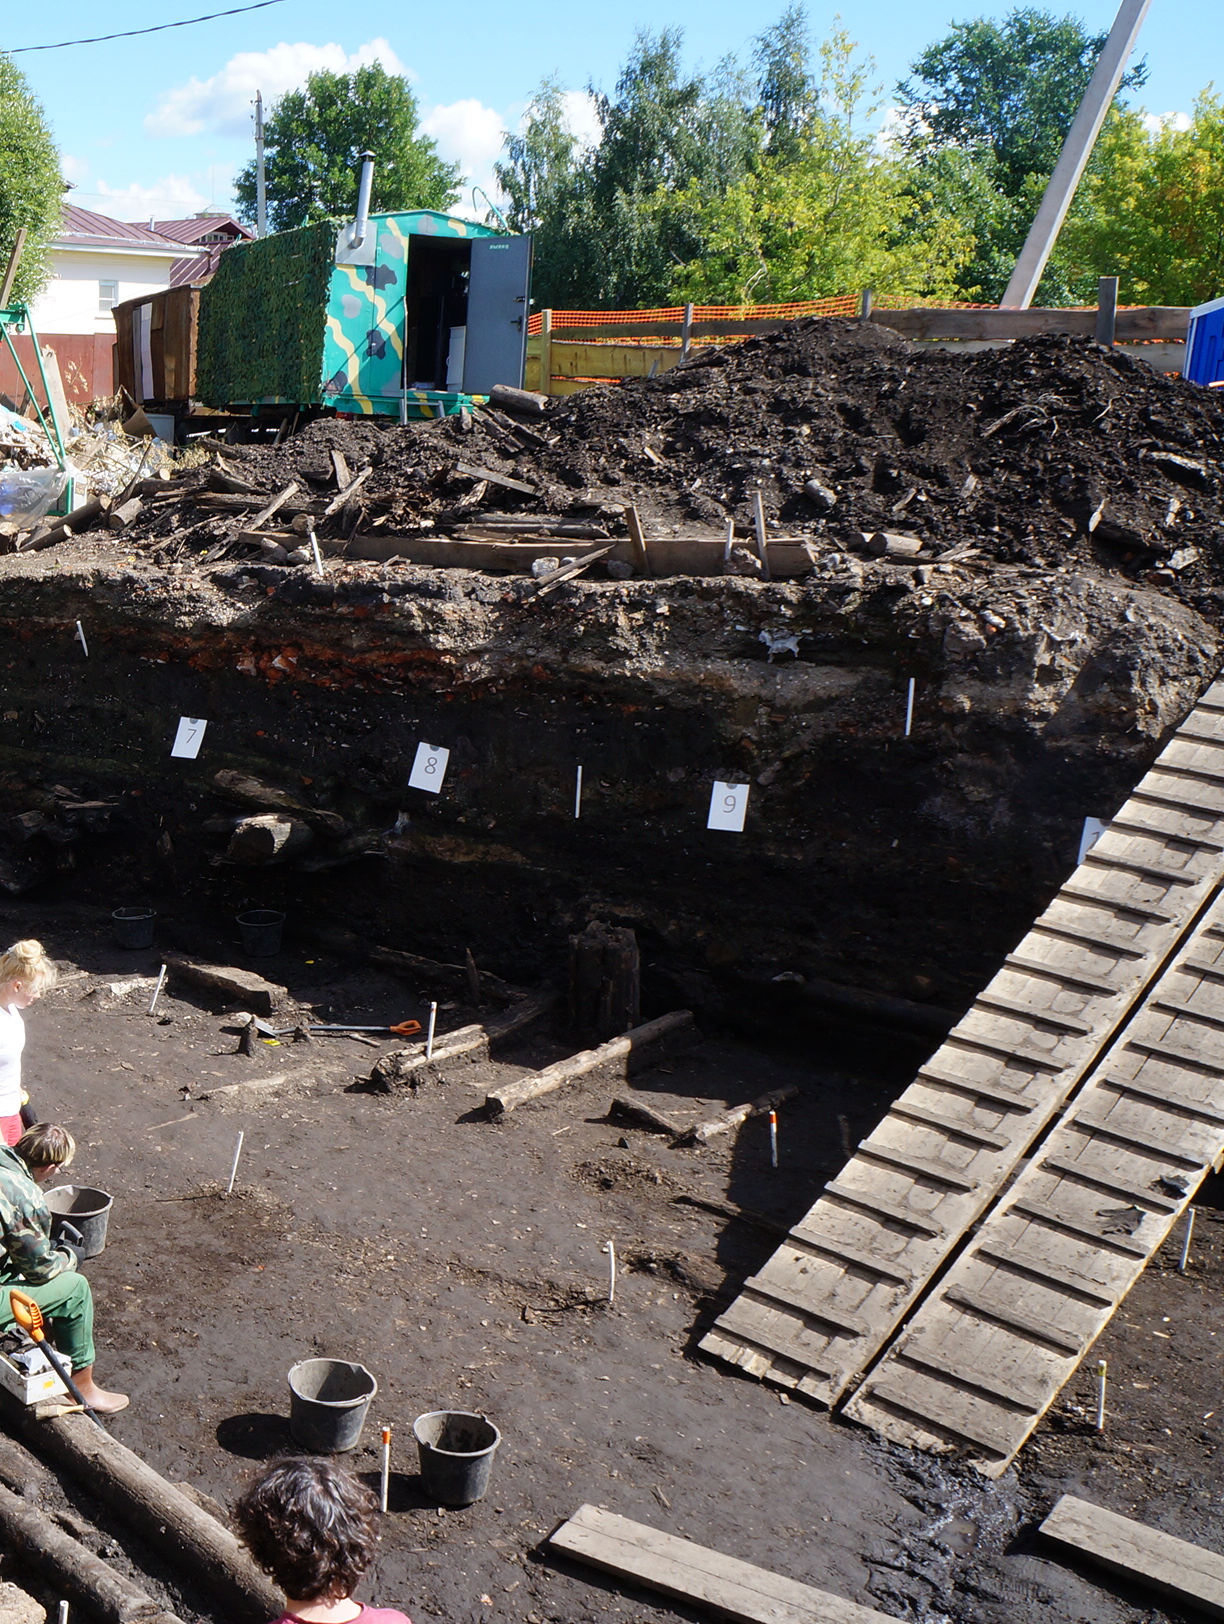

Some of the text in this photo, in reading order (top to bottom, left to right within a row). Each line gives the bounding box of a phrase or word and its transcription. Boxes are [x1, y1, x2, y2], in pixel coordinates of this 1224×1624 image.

[186, 728, 197, 743] 7
[424, 756, 438, 775] 8
[722, 795, 737, 814] 9
